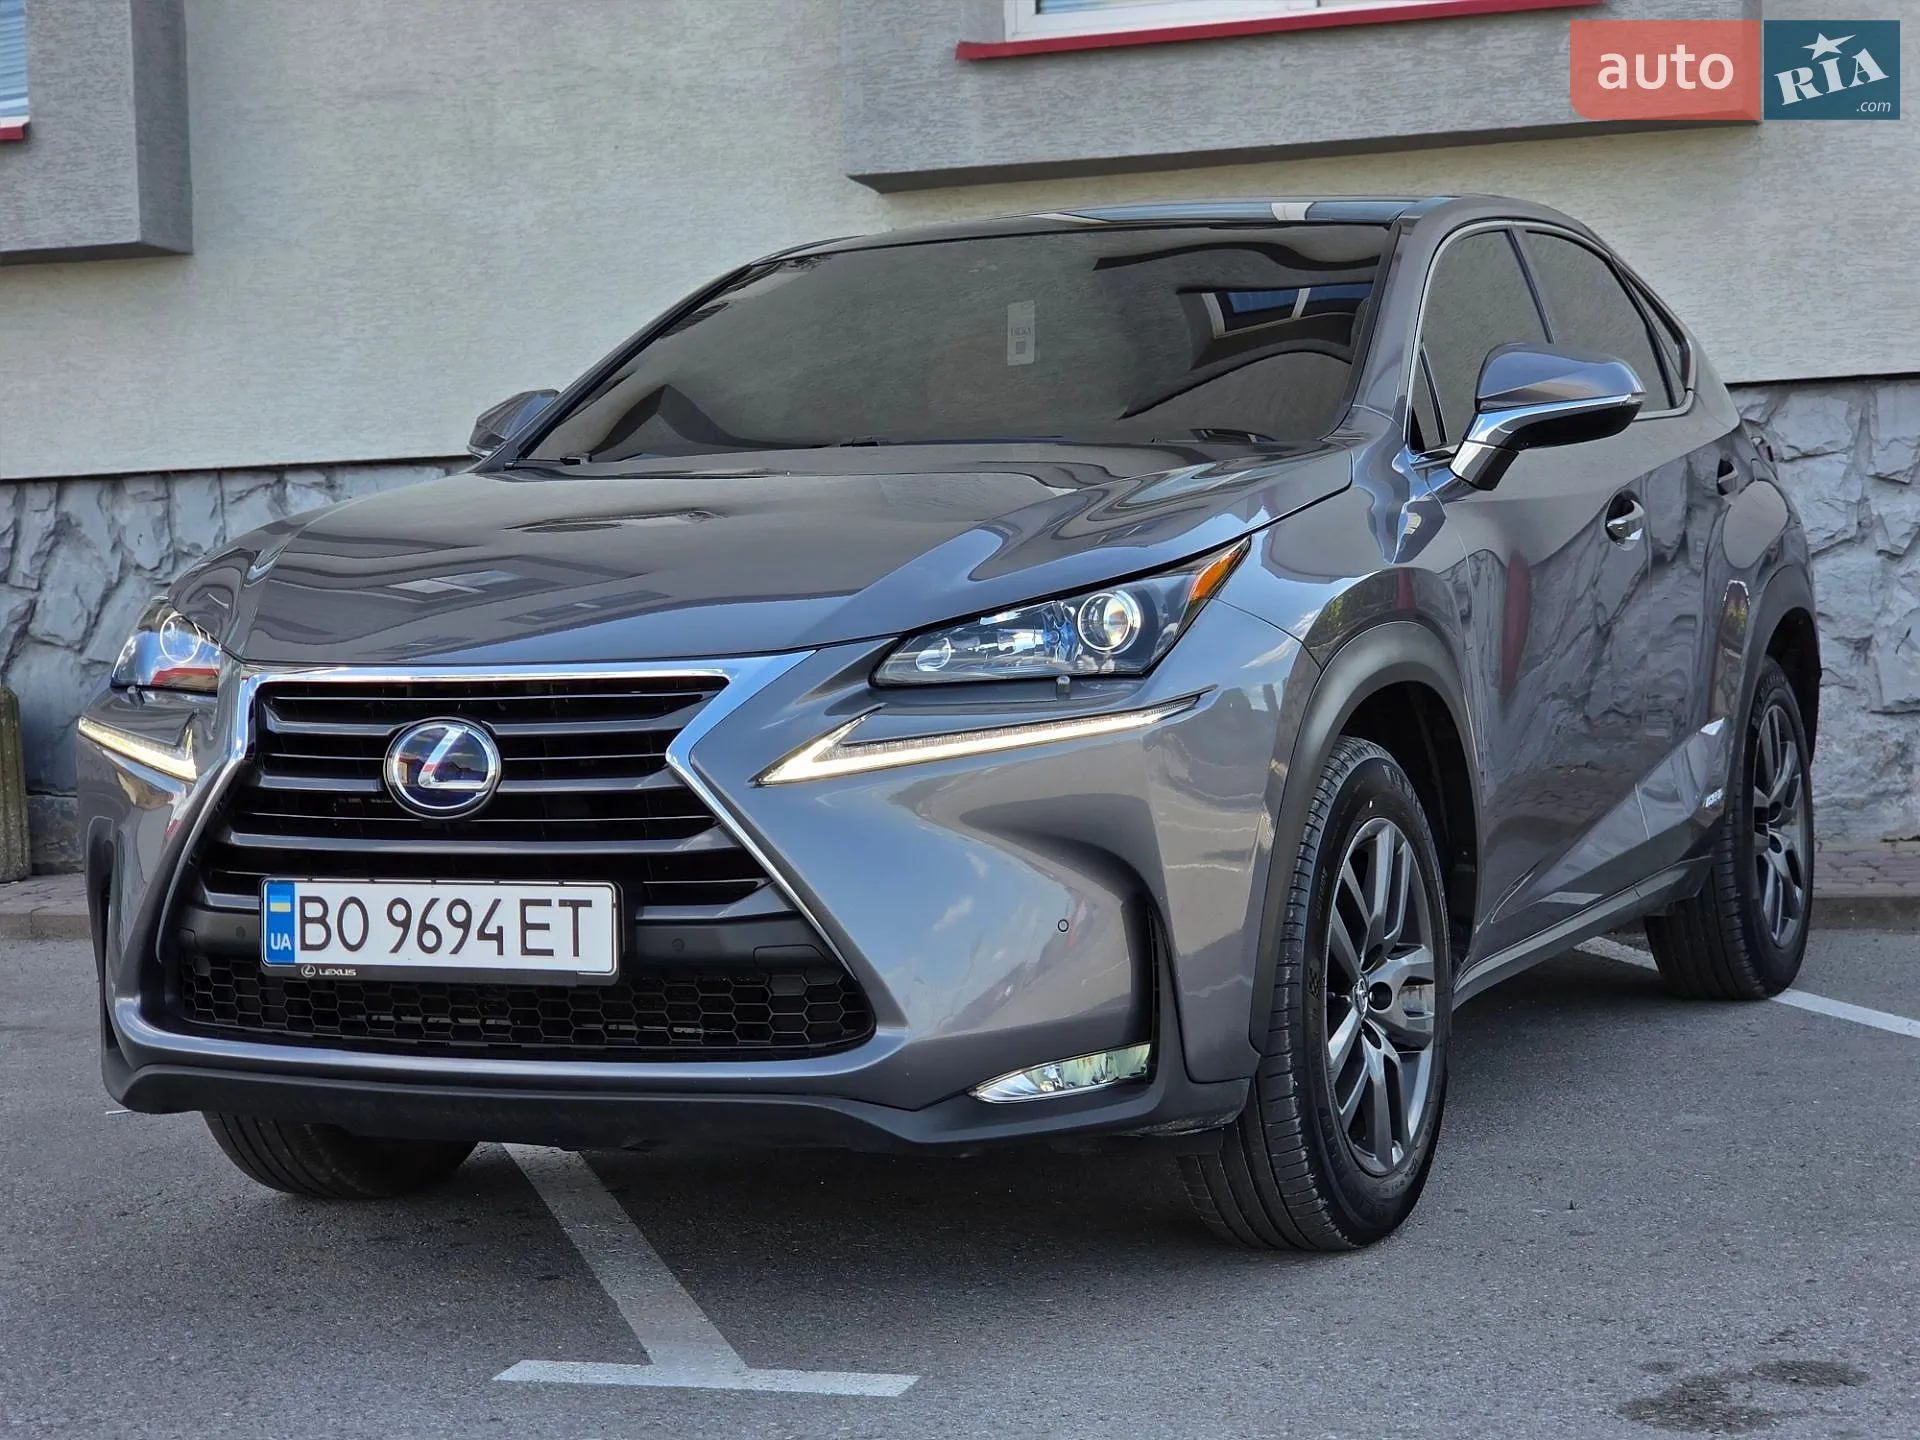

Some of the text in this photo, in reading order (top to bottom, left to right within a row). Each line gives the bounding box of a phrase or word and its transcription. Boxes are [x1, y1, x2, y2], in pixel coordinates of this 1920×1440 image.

[386, 896, 505, 957] 9694
[518, 898, 594, 958] ET
[269, 932, 292, 951] UA
[319, 967, 357, 977] LEXUS
